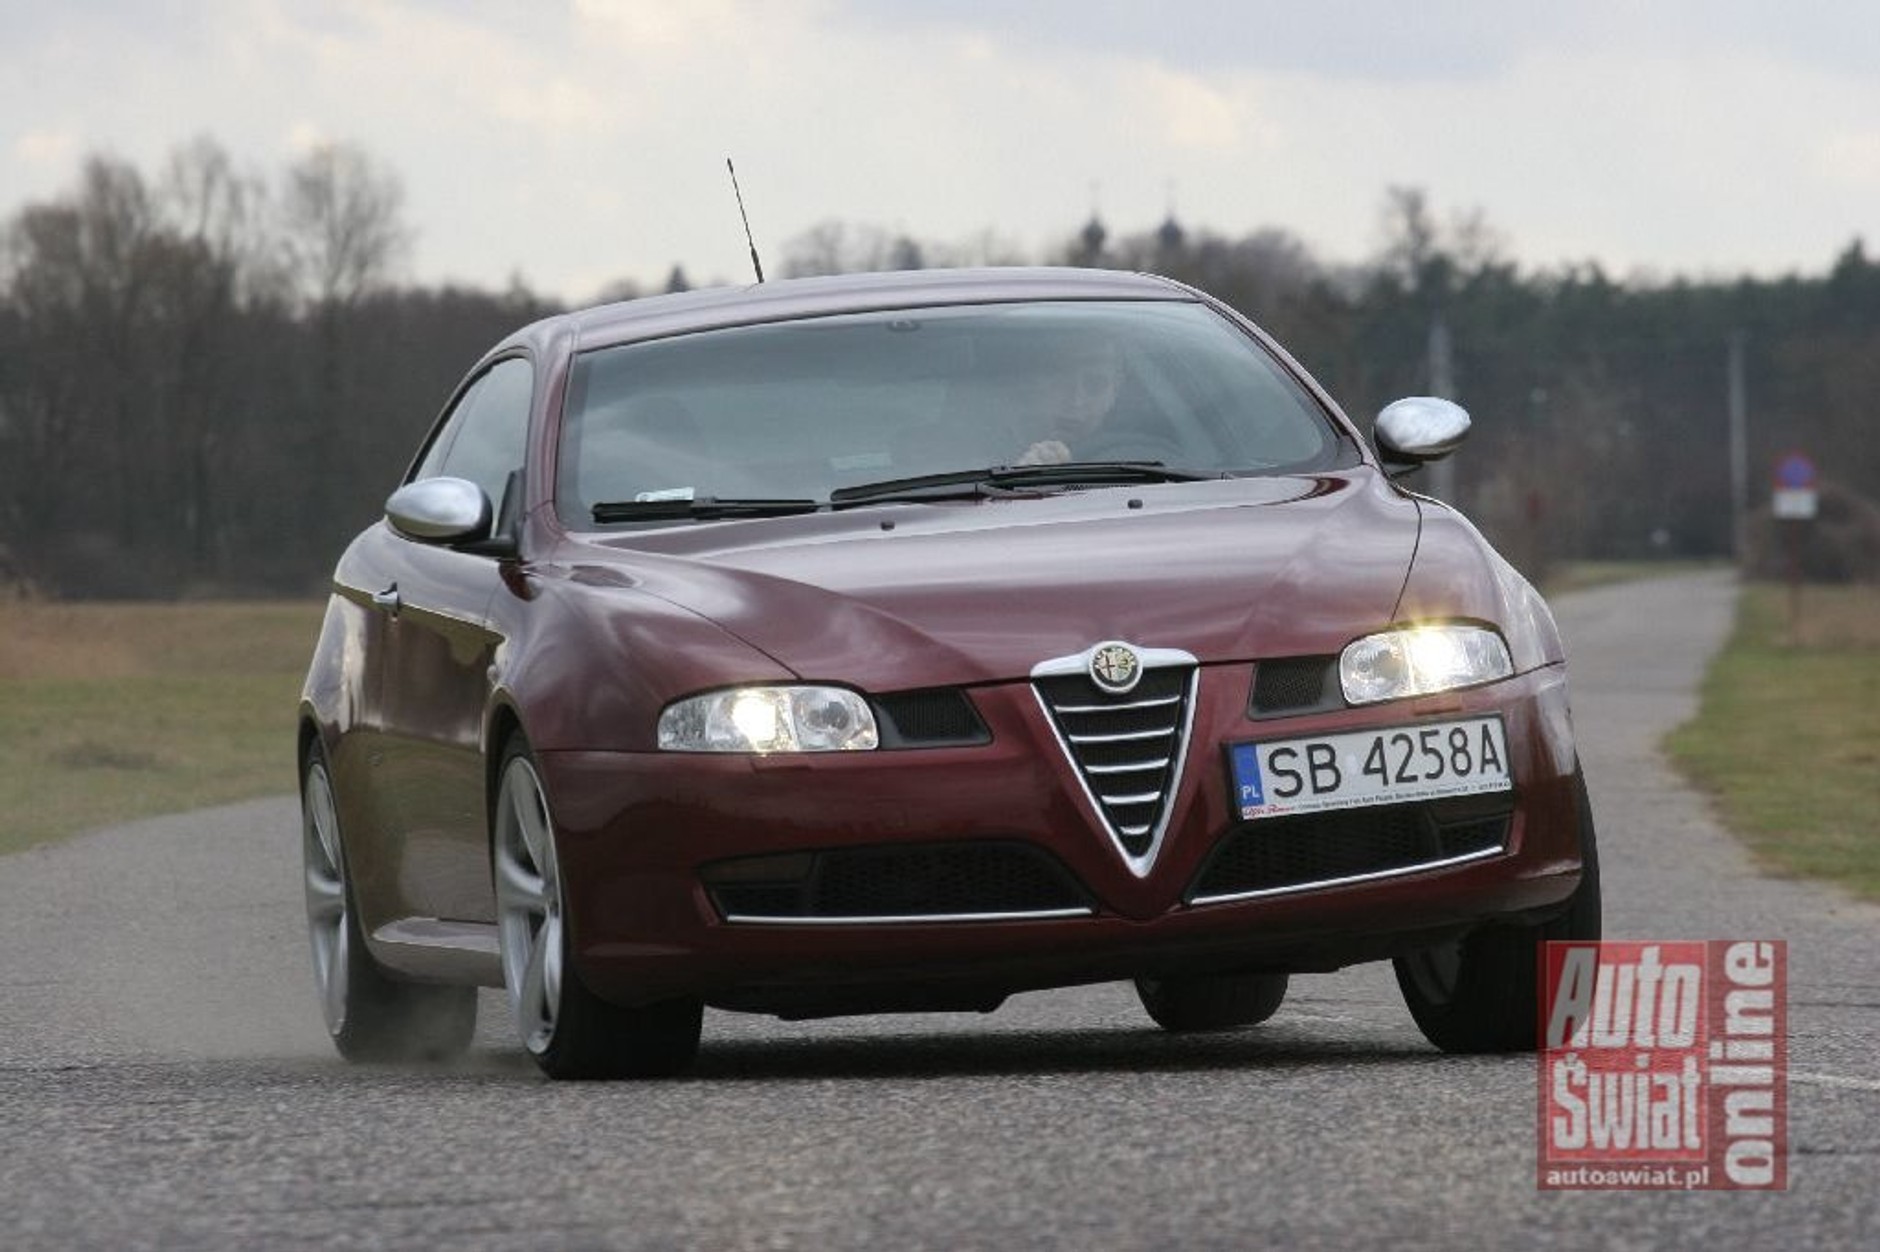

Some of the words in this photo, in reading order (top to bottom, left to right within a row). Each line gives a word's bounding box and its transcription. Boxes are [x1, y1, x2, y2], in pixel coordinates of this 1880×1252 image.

[1268, 743, 1342, 798] SB
[1362, 723, 1502, 786] 4258A
[1242, 785, 1259, 798] PL
